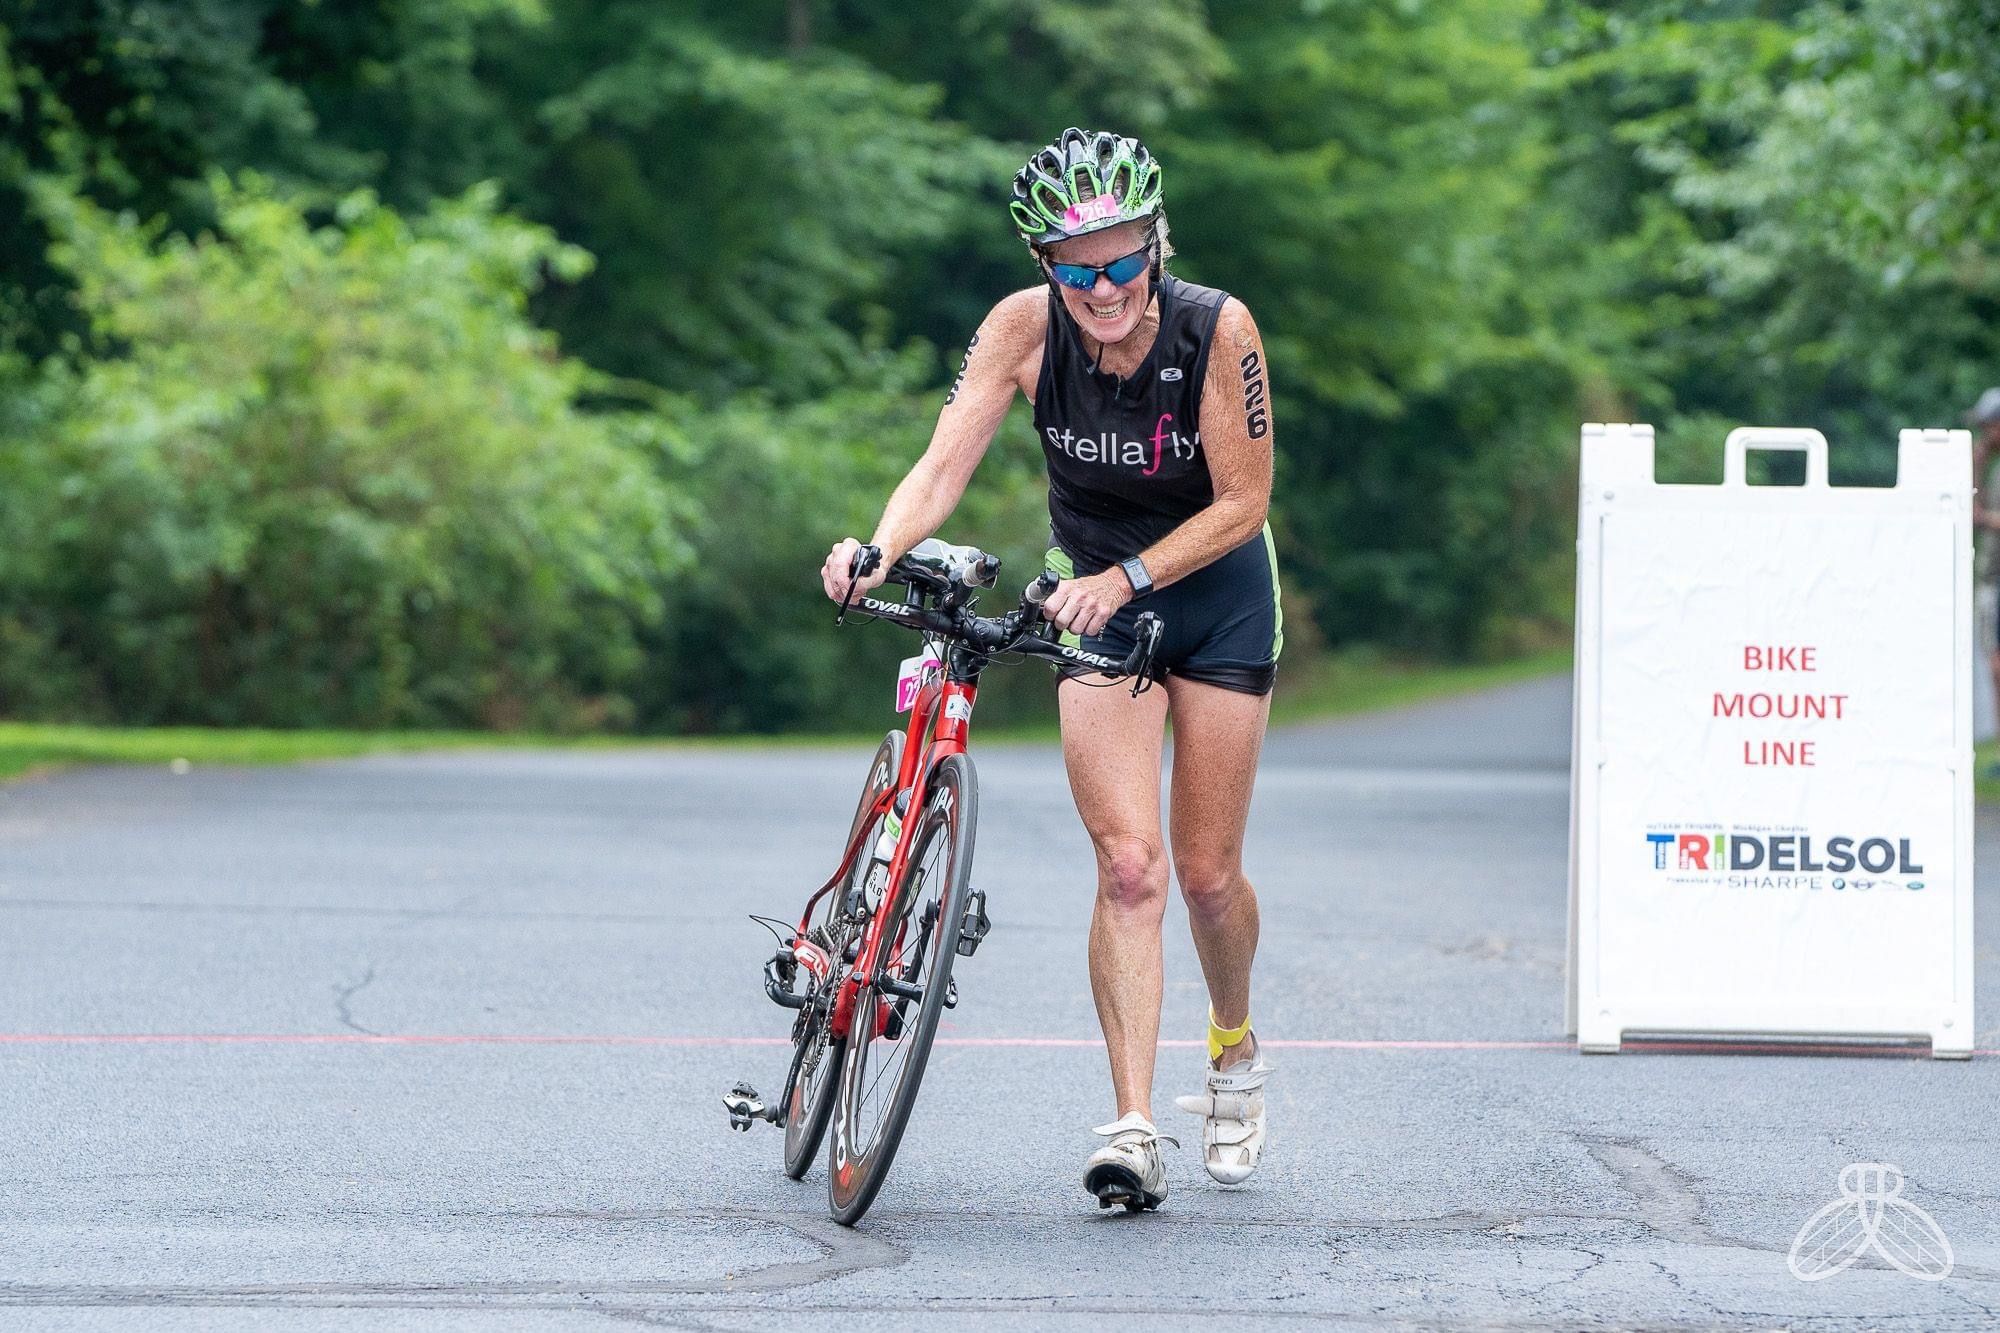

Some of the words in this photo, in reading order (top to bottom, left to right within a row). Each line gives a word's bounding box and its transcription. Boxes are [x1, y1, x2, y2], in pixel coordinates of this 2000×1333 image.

[1240, 349, 1269, 440] 226
[1046, 413, 1200, 476] stellafly
[864, 597, 910, 616] OVAL
[1061, 646, 1109, 668] OVAL
[1744, 646, 1817, 672] BIKE
[1712, 693, 1849, 720] MOUNT
[1744, 741, 1816, 767] LINE
[1646, 833, 1924, 875] TRIDELSOL
[1728, 875, 1824, 891] SHARPE
